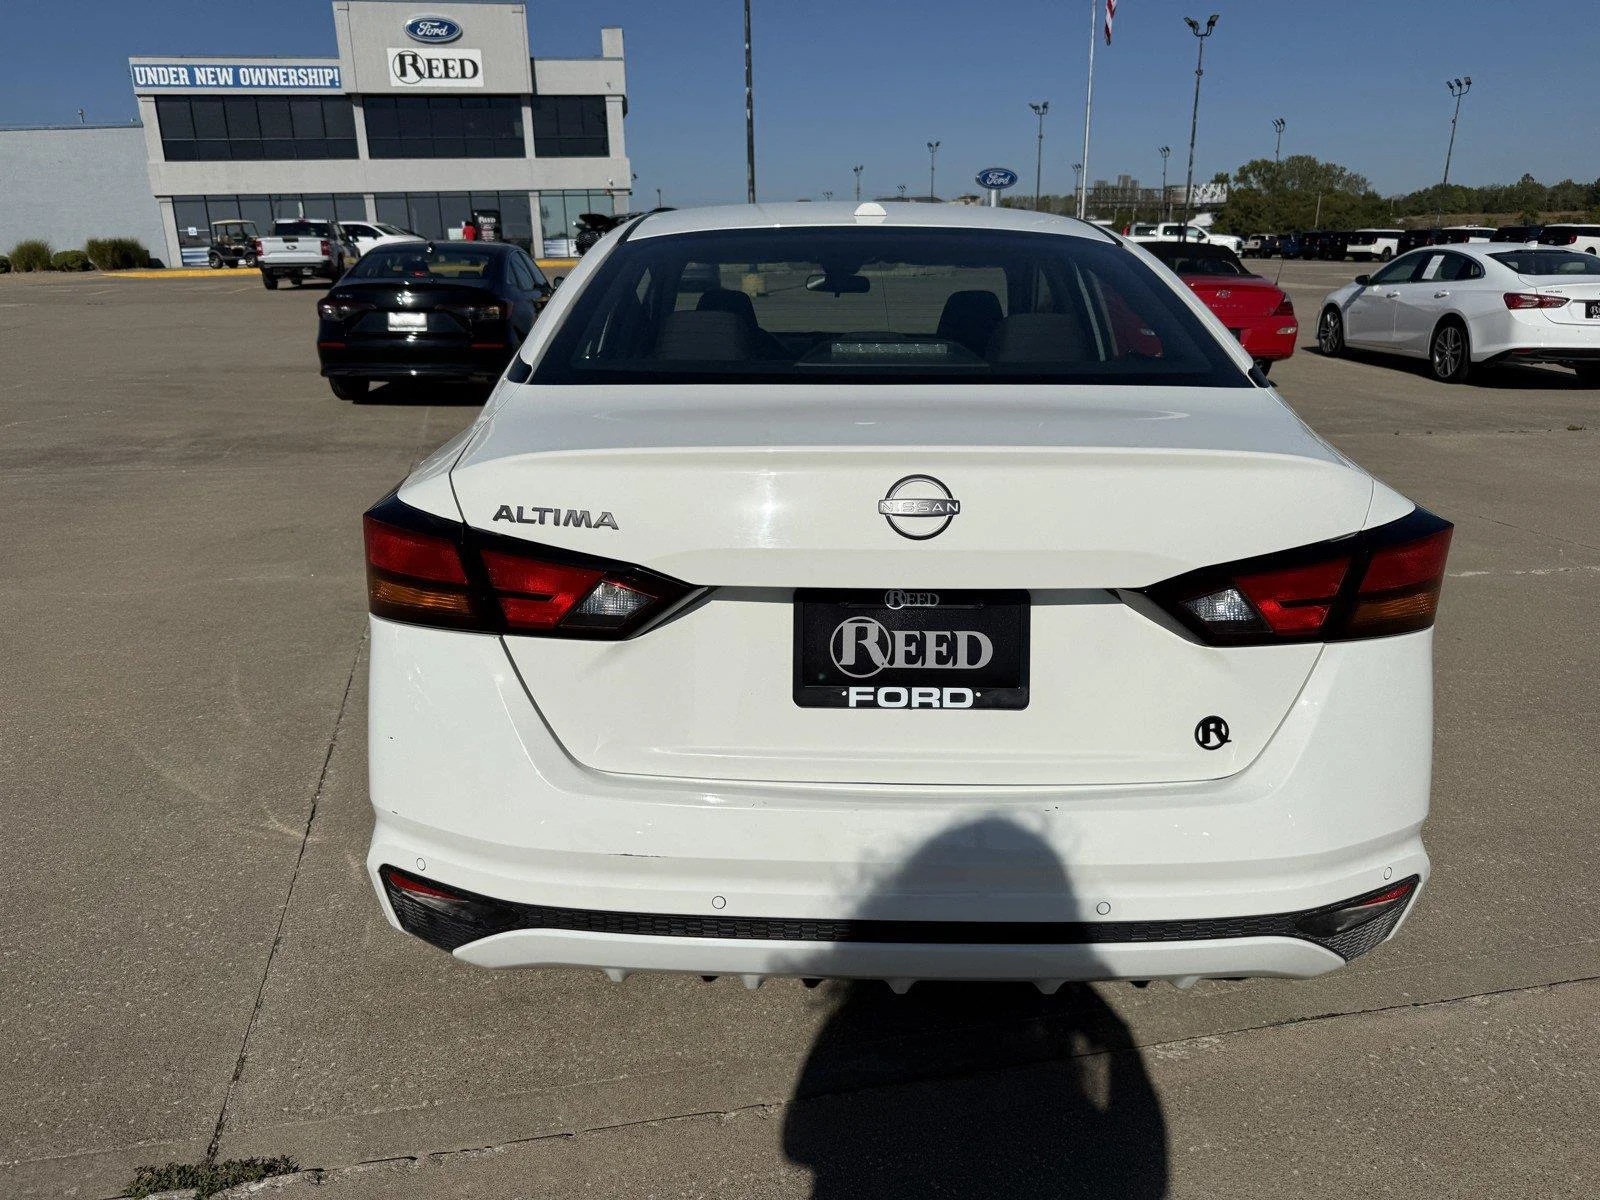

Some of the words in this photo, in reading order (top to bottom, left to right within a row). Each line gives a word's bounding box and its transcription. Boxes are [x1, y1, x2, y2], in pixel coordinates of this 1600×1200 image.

[417, 21, 449, 36] Ford
[134, 66, 190, 86] UNDER
[194, 66, 234, 86] NEW
[238, 67, 340, 87] OWNERSHIP!
[397, 52, 479, 80] REED
[987, 172, 1011, 185] Ford
[492, 504, 620, 530] ALTIMA
[887, 589, 940, 607] REED
[836, 620, 994, 670] REED
[848, 686, 974, 709] FORD
